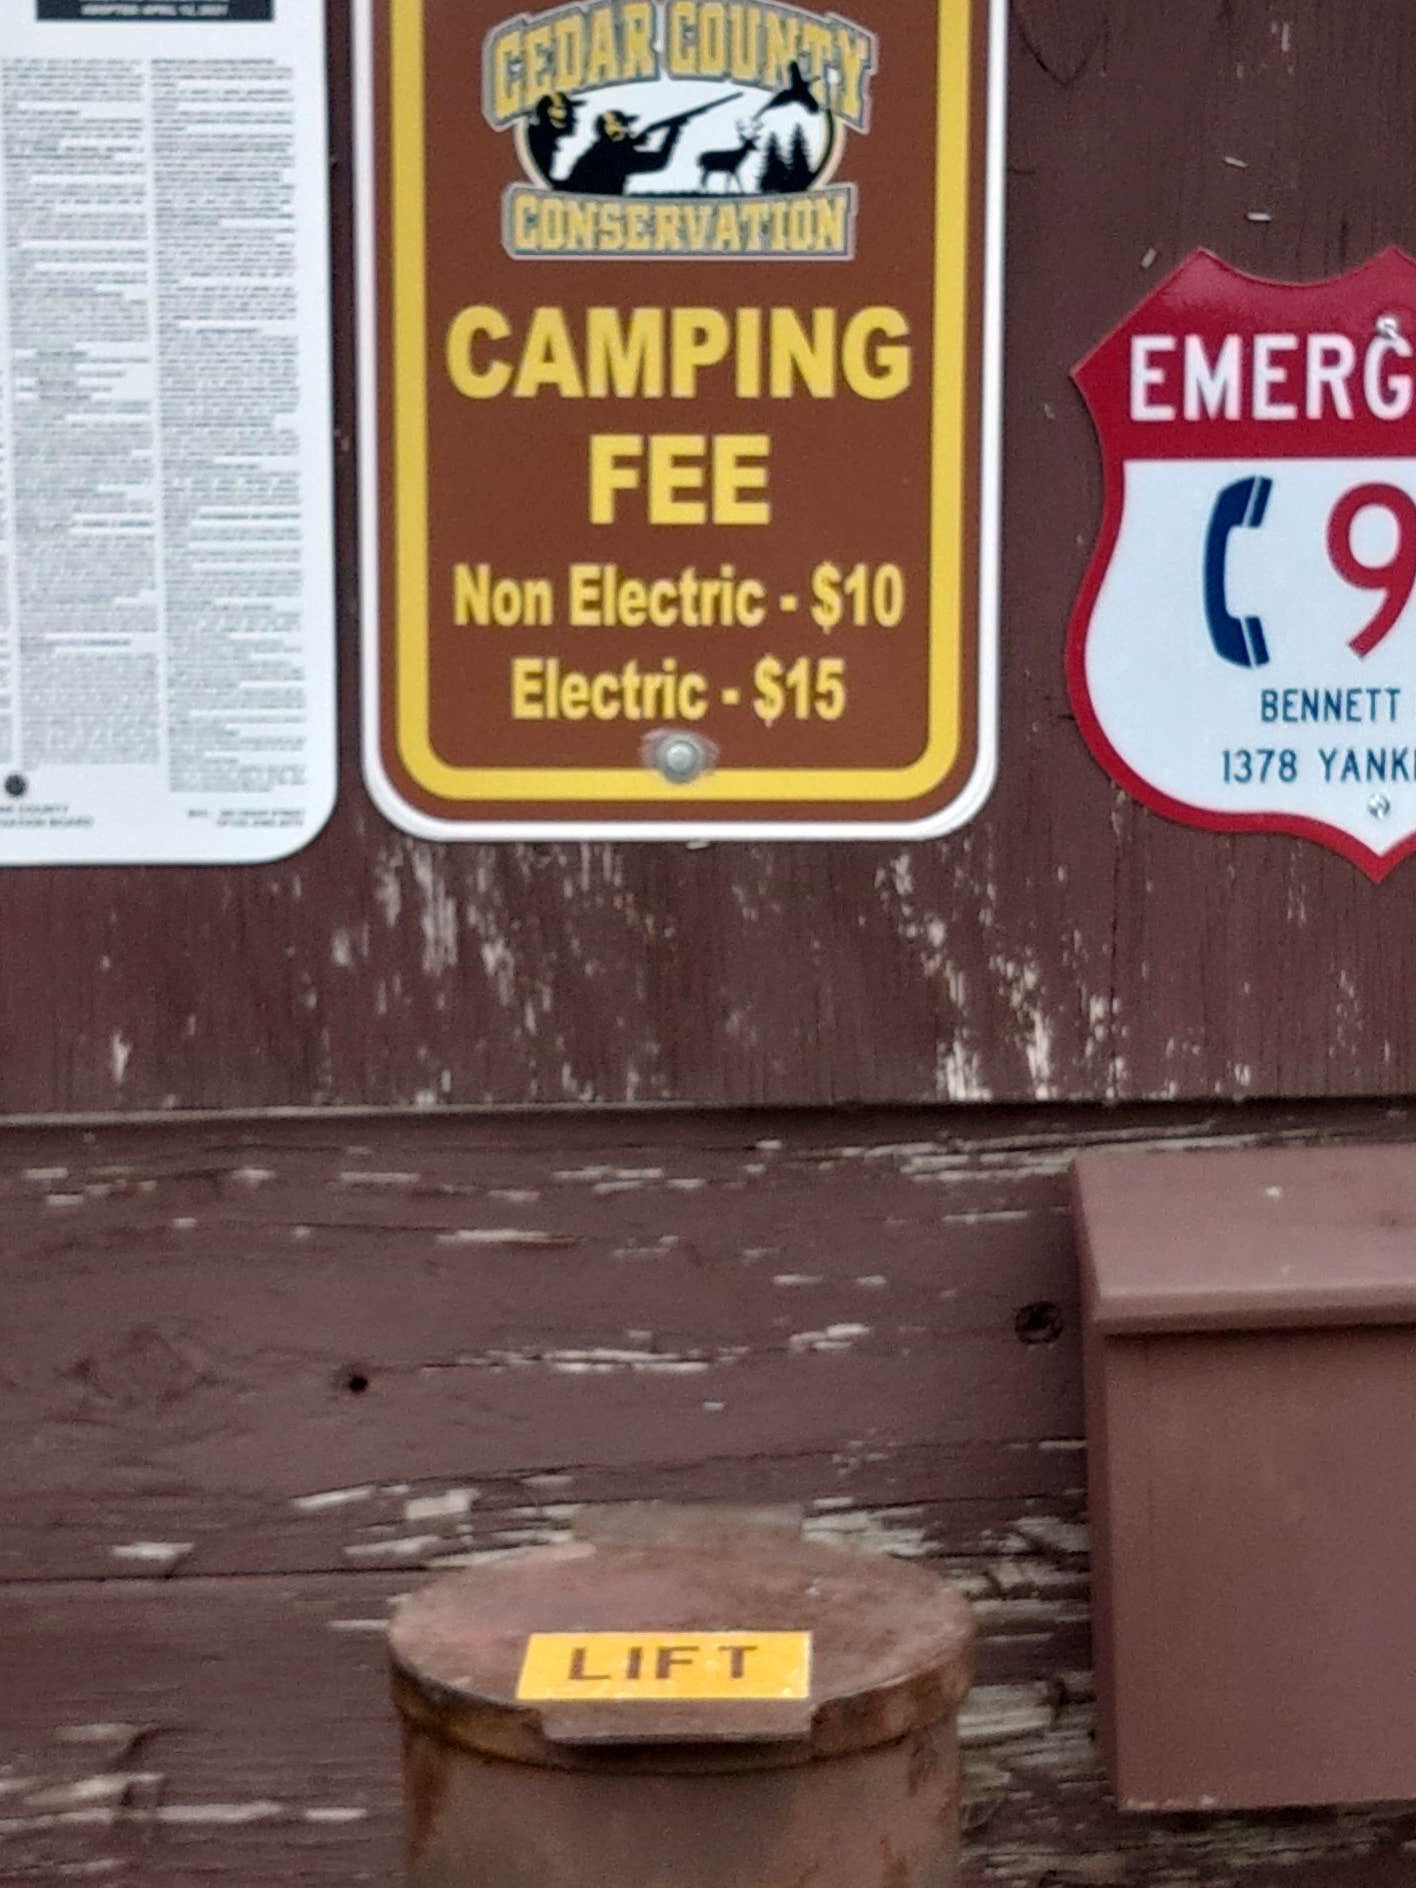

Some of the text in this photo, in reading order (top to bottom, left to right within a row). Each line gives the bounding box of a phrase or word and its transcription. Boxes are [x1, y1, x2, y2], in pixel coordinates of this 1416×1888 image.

[490, 0, 657, 122] CEDAR
[510, 192, 851, 254] CONSERVATION
[444, 304, 913, 400] CAMPING
[588, 433, 772, 526] FEE
[452, 562, 554, 627] Non
[568, 562, 767, 628] Electric
[810, 560, 906, 635] $10
[510, 657, 709, 722] Electric
[753, 653, 848, 729] $15
[1259, 686, 1403, 724] BENNETT
[1220, 747, 1300, 786] 1378
[567, 1644, 760, 1682] LIFT
